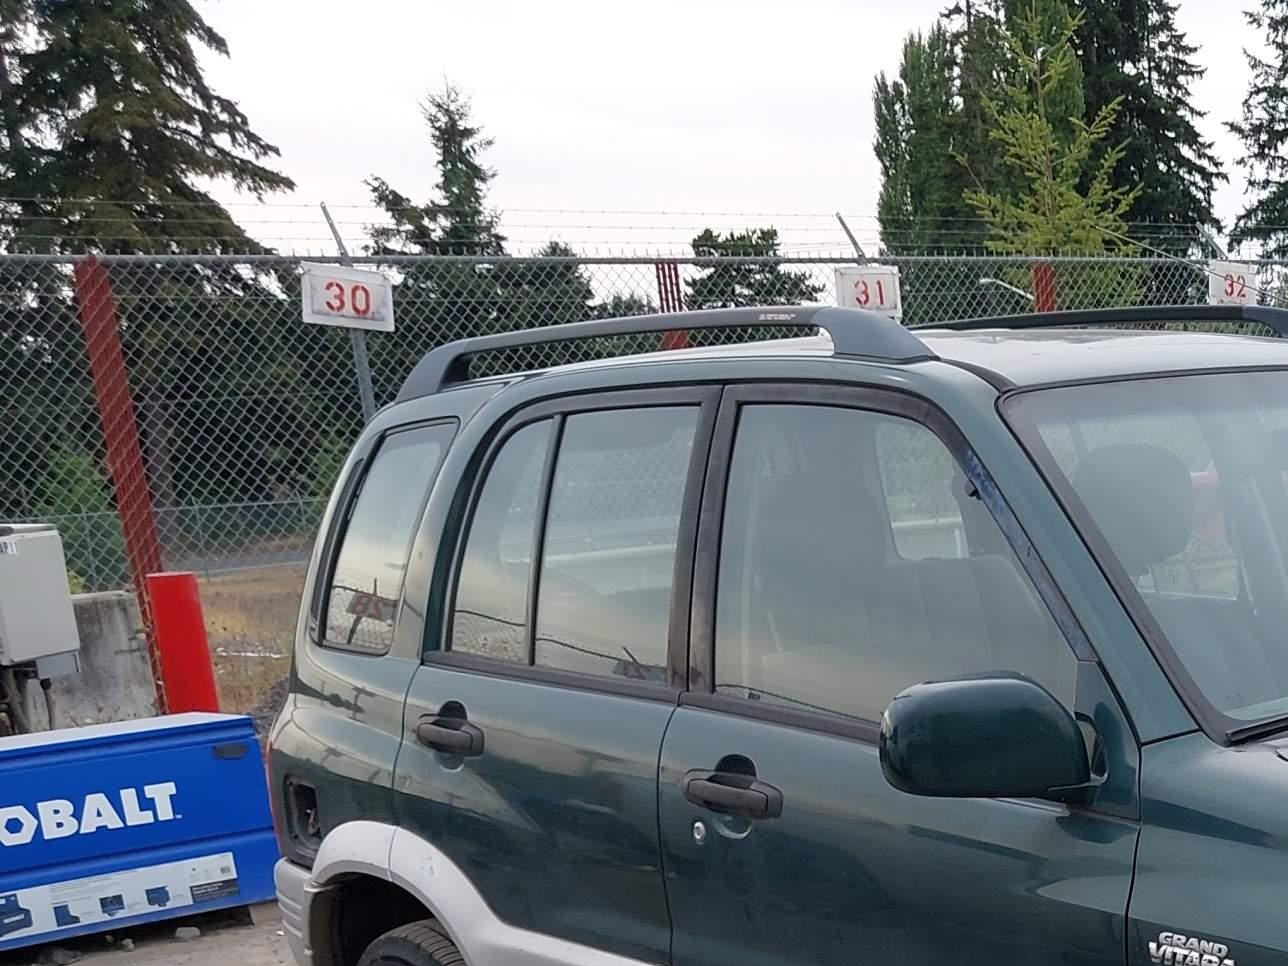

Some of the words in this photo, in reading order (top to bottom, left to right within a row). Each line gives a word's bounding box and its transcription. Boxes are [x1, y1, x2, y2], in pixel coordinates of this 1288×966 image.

[325, 281, 370, 315] 30
[854, 280, 884, 306] 31
[1224, 273, 1246, 298] 32
[1158, 931, 1228, 958] GRAND
